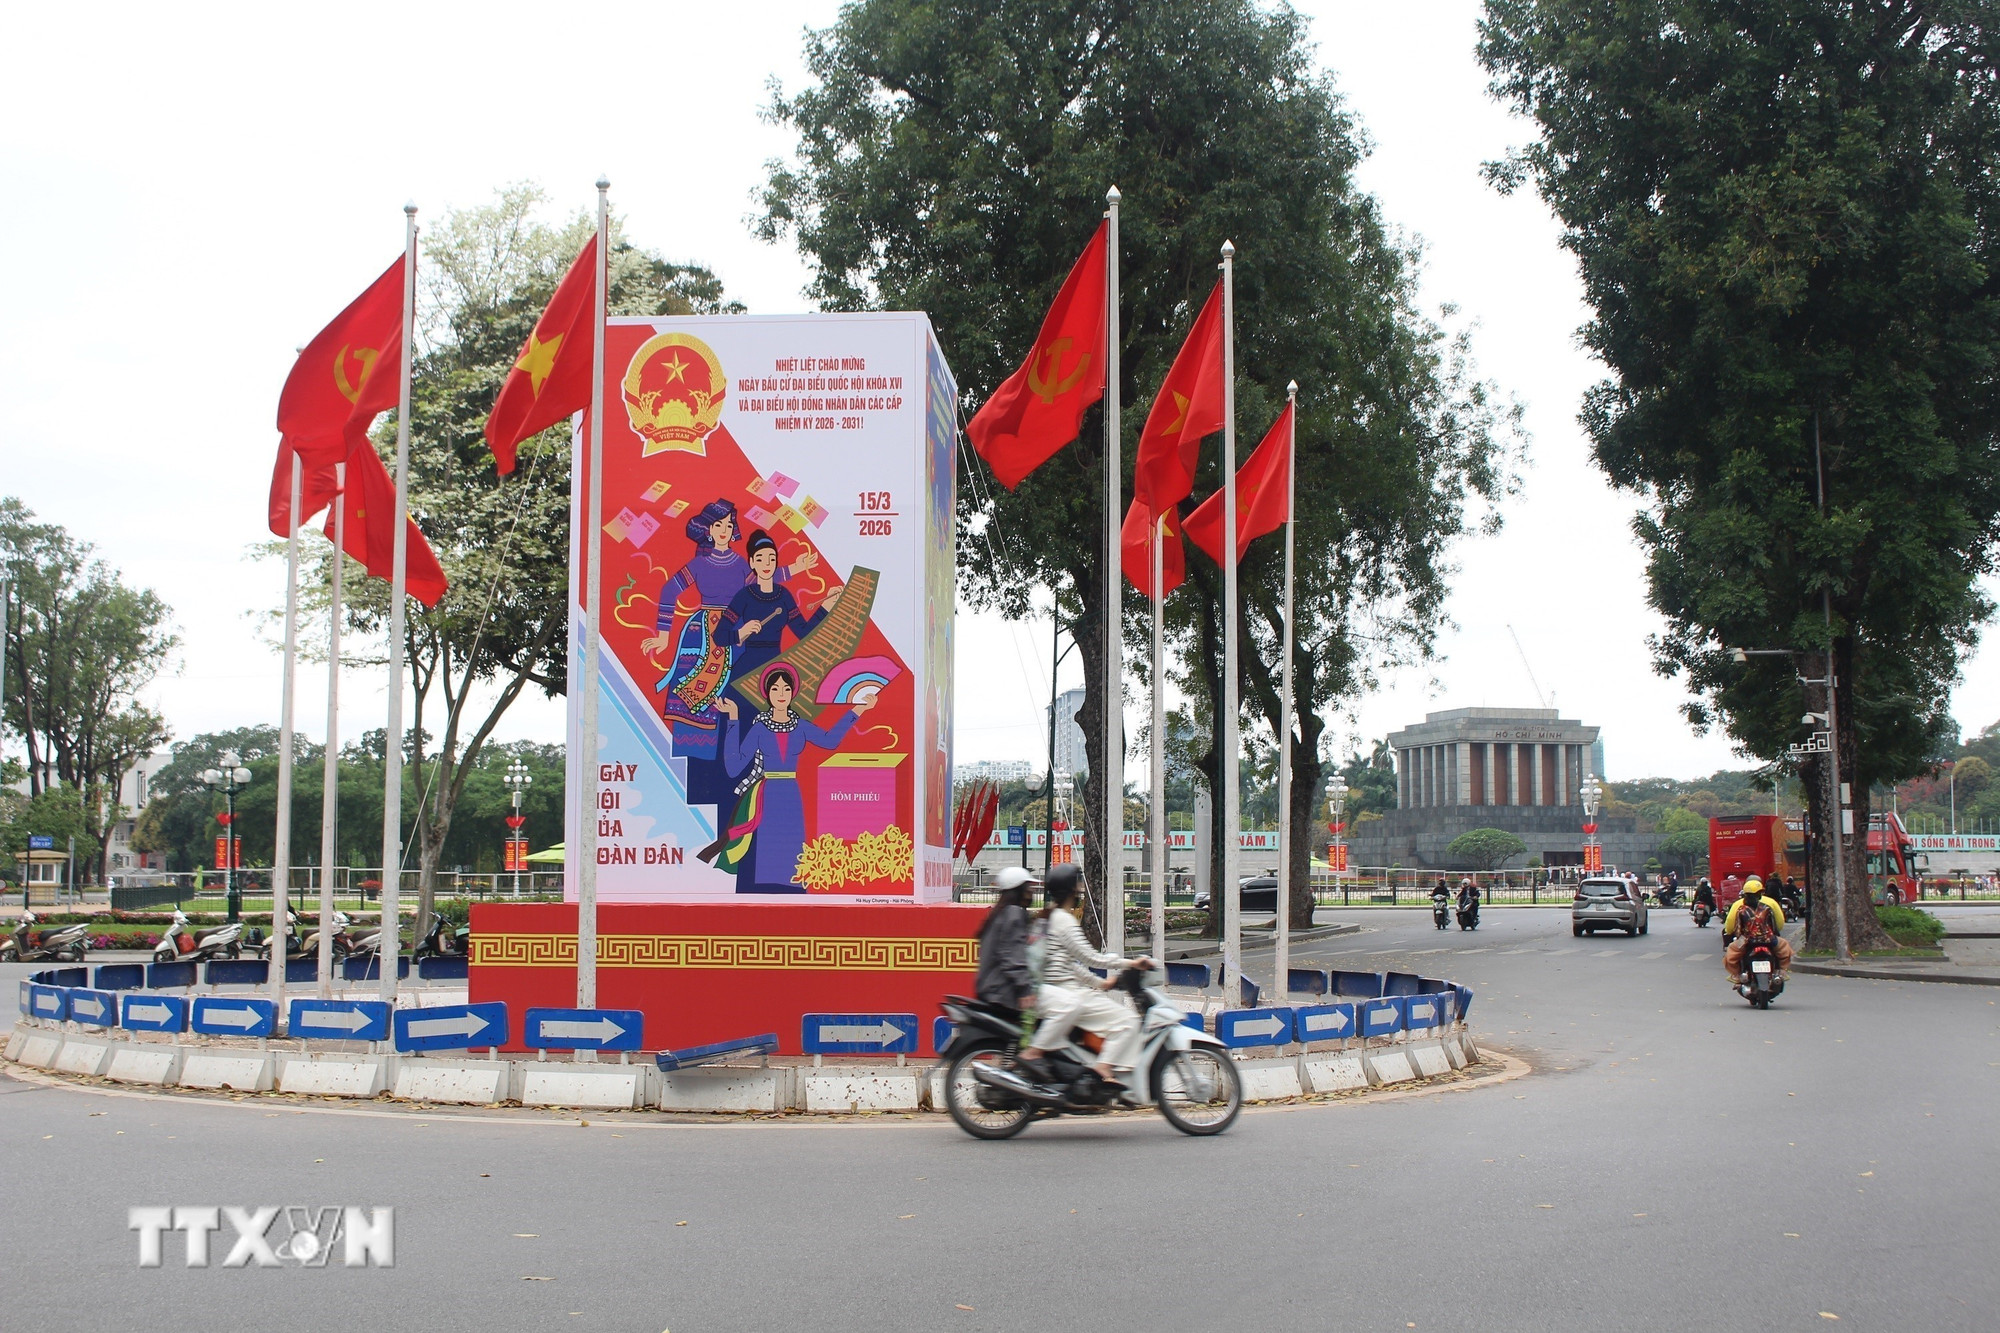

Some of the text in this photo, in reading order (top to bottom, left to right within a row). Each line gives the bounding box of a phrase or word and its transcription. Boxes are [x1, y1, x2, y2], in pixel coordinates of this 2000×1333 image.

[775, 355, 865, 374] NHIỆT LIỆT CHÀO MỪNG
[738, 373, 902, 394] NGÀY BẦU CỬ ĐẠI BIỂU QUỐC HỘI KHÓA XVI
[738, 393, 902, 414] VÀ ĐẠI BIỂU HỘI ĐỒNG NHÂN DÂN CÁC CẤP
[775, 415, 801, 432] NHIỆM
[803, 414, 813, 430] KỲ
[815, 417, 834, 429] 2026
[842, 416, 864, 429] 2031!
[675, 432, 690, 440] NAM
[858, 491, 891, 510] 15/3
[859, 519, 892, 536] 2026
[597, 760, 638, 782] GÀY
[598, 815, 623, 837] ỦA
[1165, 834, 1186, 846] AM
[1921, 834, 1945, 848] SỐNG
[1967, 838, 1996, 848] TRONG
[597, 843, 684, 865] OÀN DÂN
